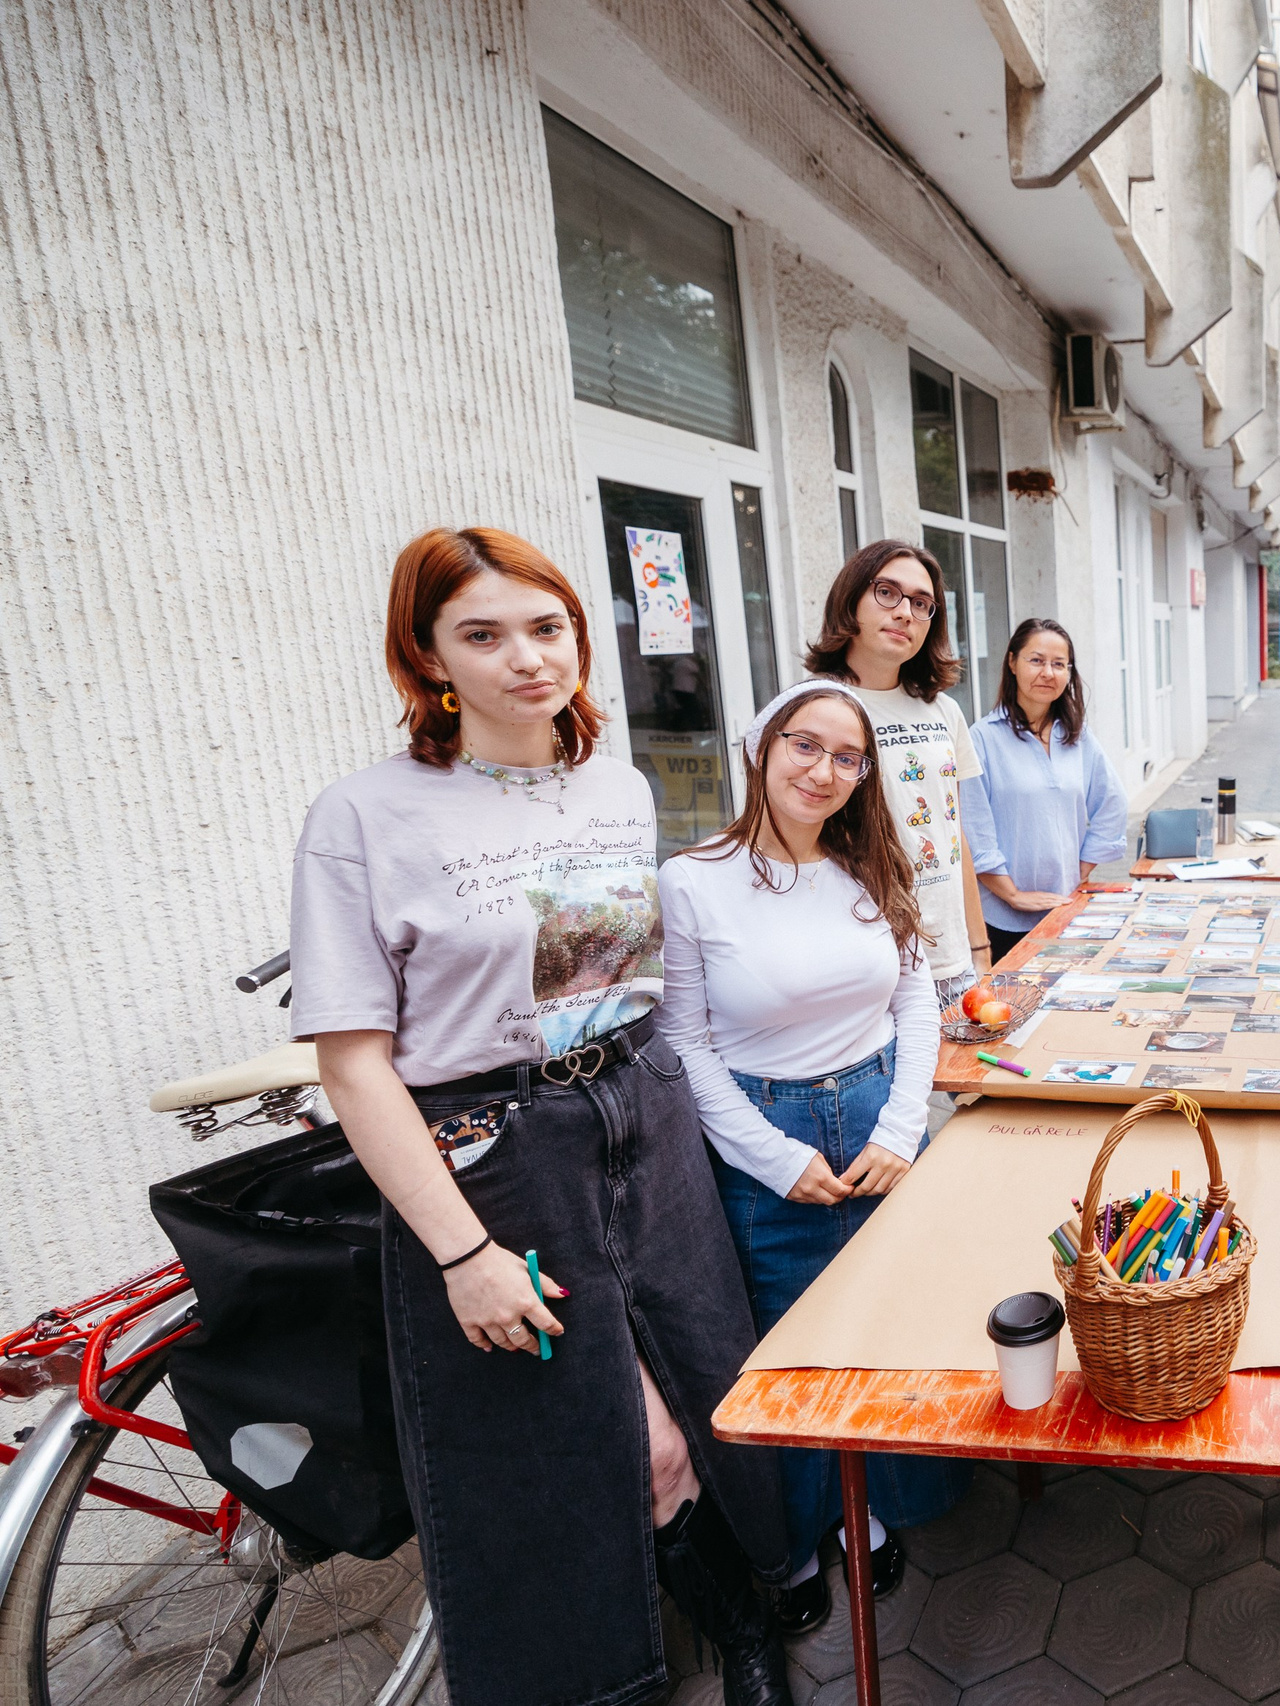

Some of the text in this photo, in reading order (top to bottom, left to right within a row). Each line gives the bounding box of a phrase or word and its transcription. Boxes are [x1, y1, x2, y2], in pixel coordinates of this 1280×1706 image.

[876, 723, 948, 735] OSE YOUR
[877, 735, 930, 748] RACER
[588, 818, 620, 828] Claude
[442, 858, 473, 875] The
[532, 839, 572, 861] Garden
[574, 840, 585, 848] in
[585, 836, 642, 854] Argenteuil
[486, 872, 528, 888] Corner
[531, 862, 545, 881] of
[549, 858, 563, 872] the
[563, 858, 602, 879] Garden
[606, 857, 628, 868] with
[478, 896, 514, 914] 1873
[565, 993, 600, 1008] Seine
